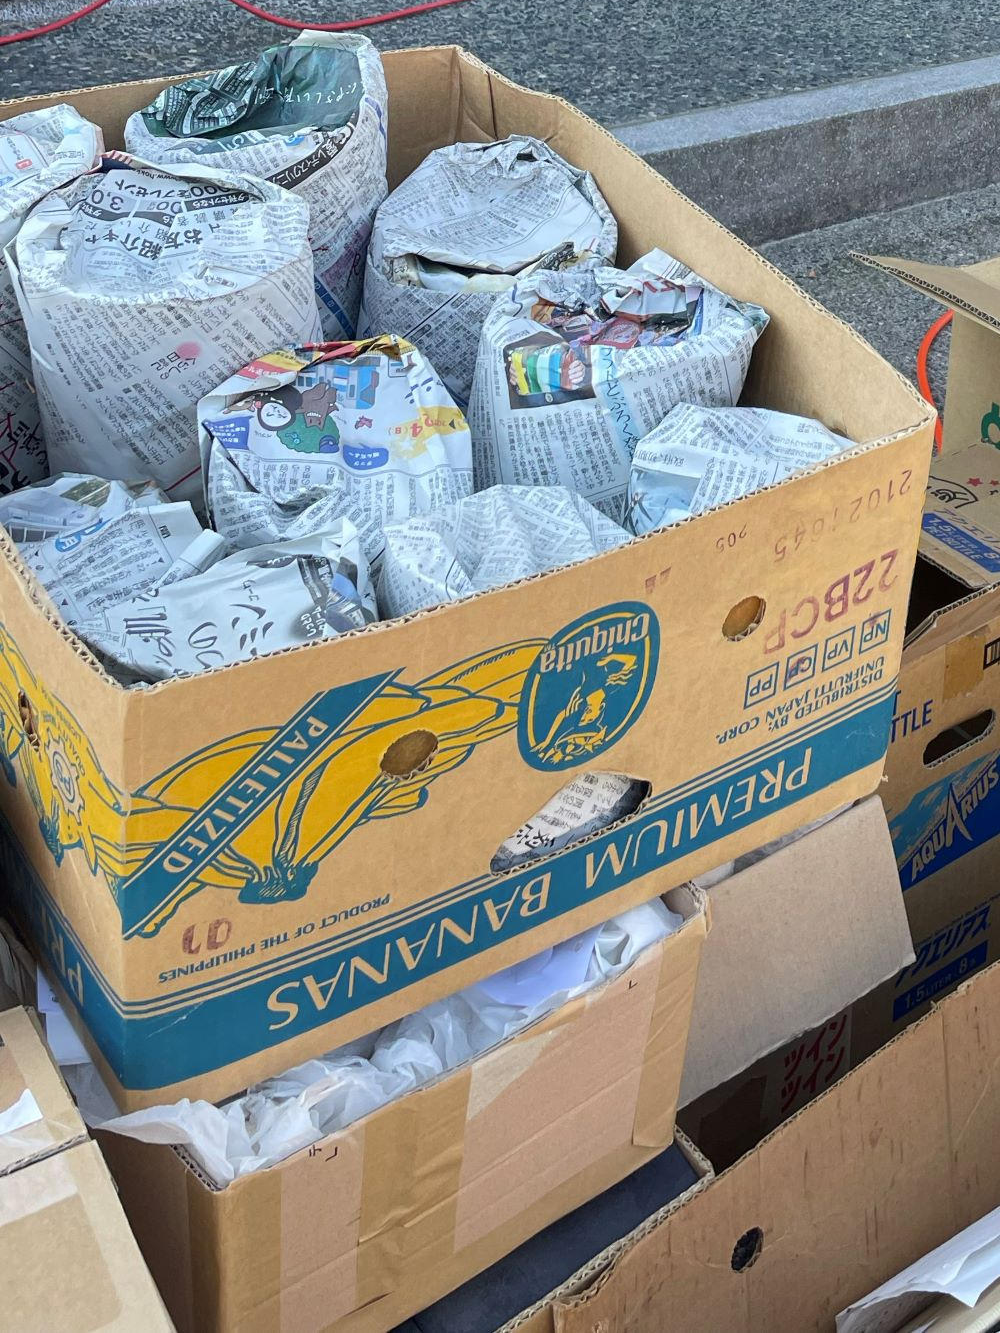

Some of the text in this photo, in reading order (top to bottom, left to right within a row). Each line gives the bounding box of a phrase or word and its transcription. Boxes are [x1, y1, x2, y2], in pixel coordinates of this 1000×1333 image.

[539, 613, 651, 674] Chiquita
[788, 656, 812, 681] CP
[827, 639, 849, 661] VP
[864, 619, 887, 643] NP
[715, 656, 885, 745] UNIFRUTTI JAPAN CORP.
[749, 674, 774, 698] PP
[795, 668, 884, 720] DISTRIBUTED
[162, 715, 330, 874] PALLETIZED
[585, 747, 813, 891] PREMIUM
[910, 762, 1000, 882] AQUARIUS
[158, 893, 391, 984] PRODUCT OF THE PHILIPPINES
[266, 877, 551, 1033] BANANAS
